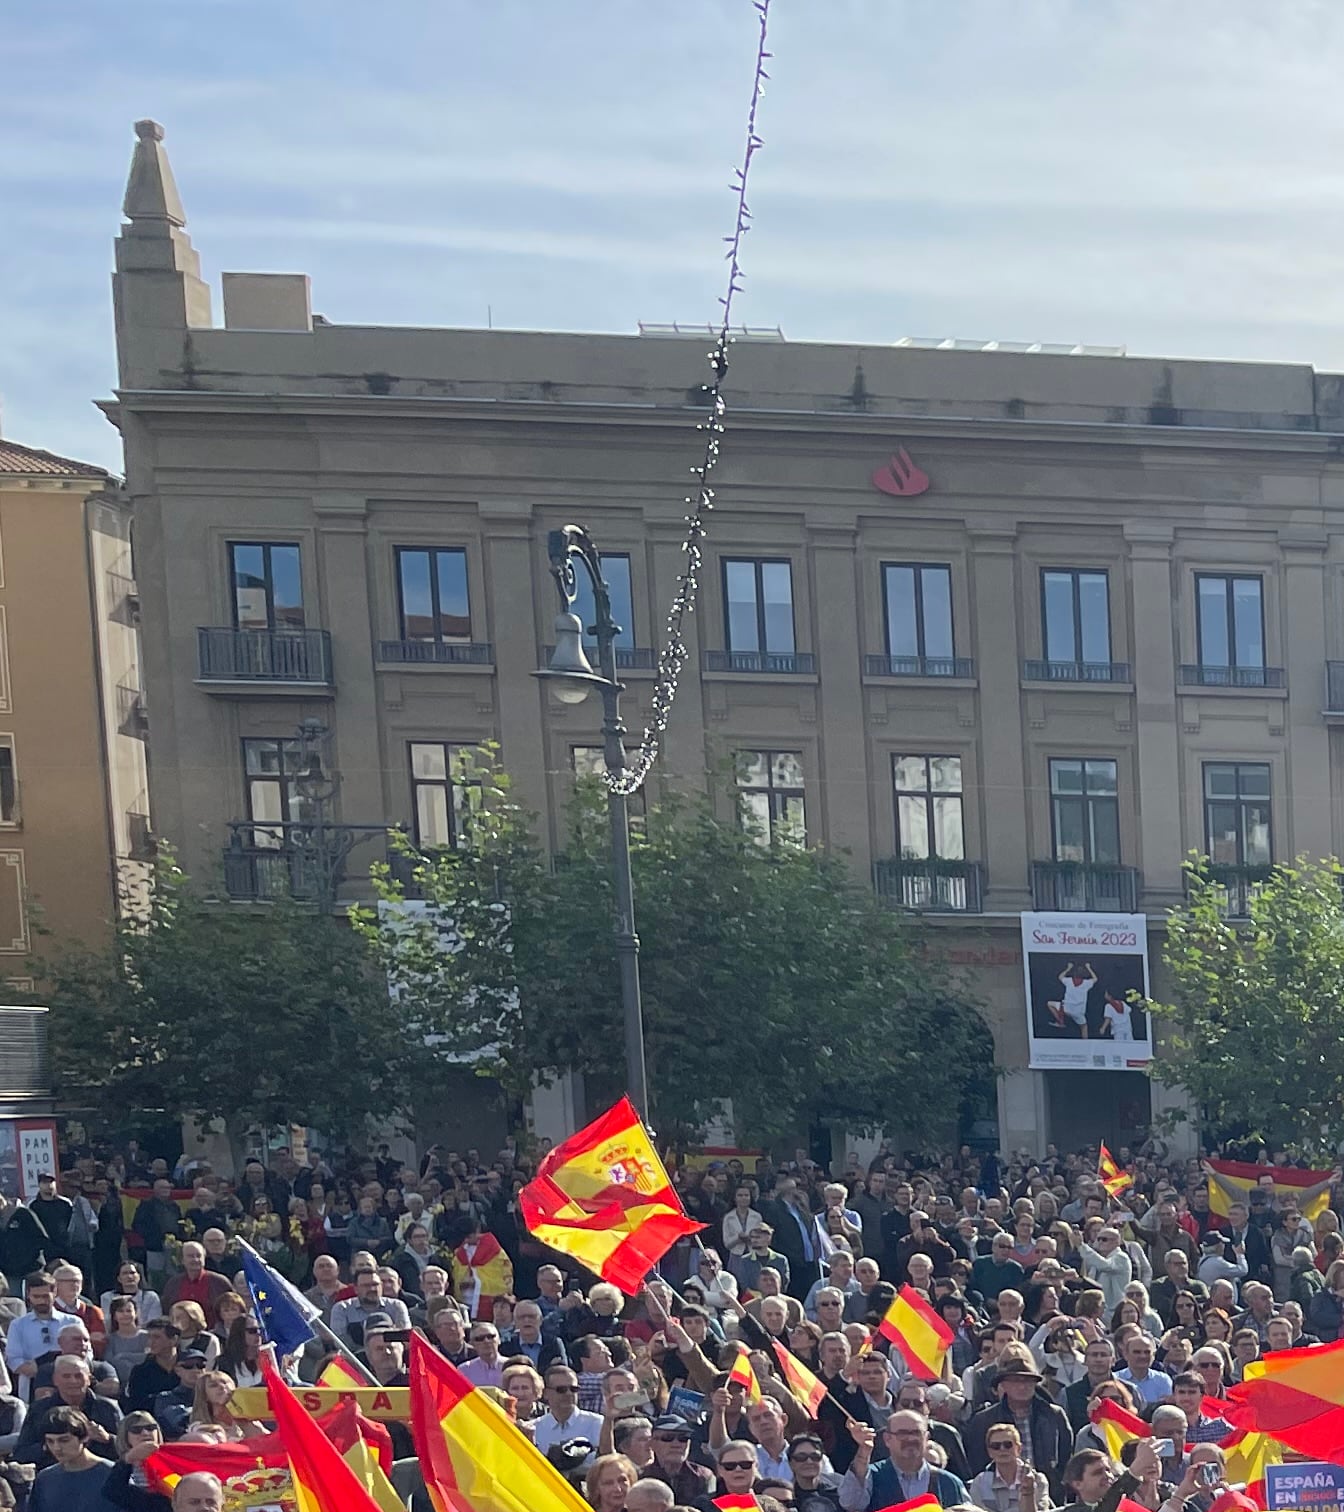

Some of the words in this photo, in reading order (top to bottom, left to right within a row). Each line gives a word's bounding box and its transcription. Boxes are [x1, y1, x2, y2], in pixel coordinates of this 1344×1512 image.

[1032, 929, 1056, 945] San
[1056, 931, 1098, 945] Fermín
[1101, 931, 1137, 946] 2023
[25, 1137, 49, 1150] PAM
[26, 1153, 50, 1165] PLO
[1274, 1472, 1335, 1490] ESPAÑA
[1275, 1491, 1297, 1504] EN
[1336, 1487, 1344, 1500] E
